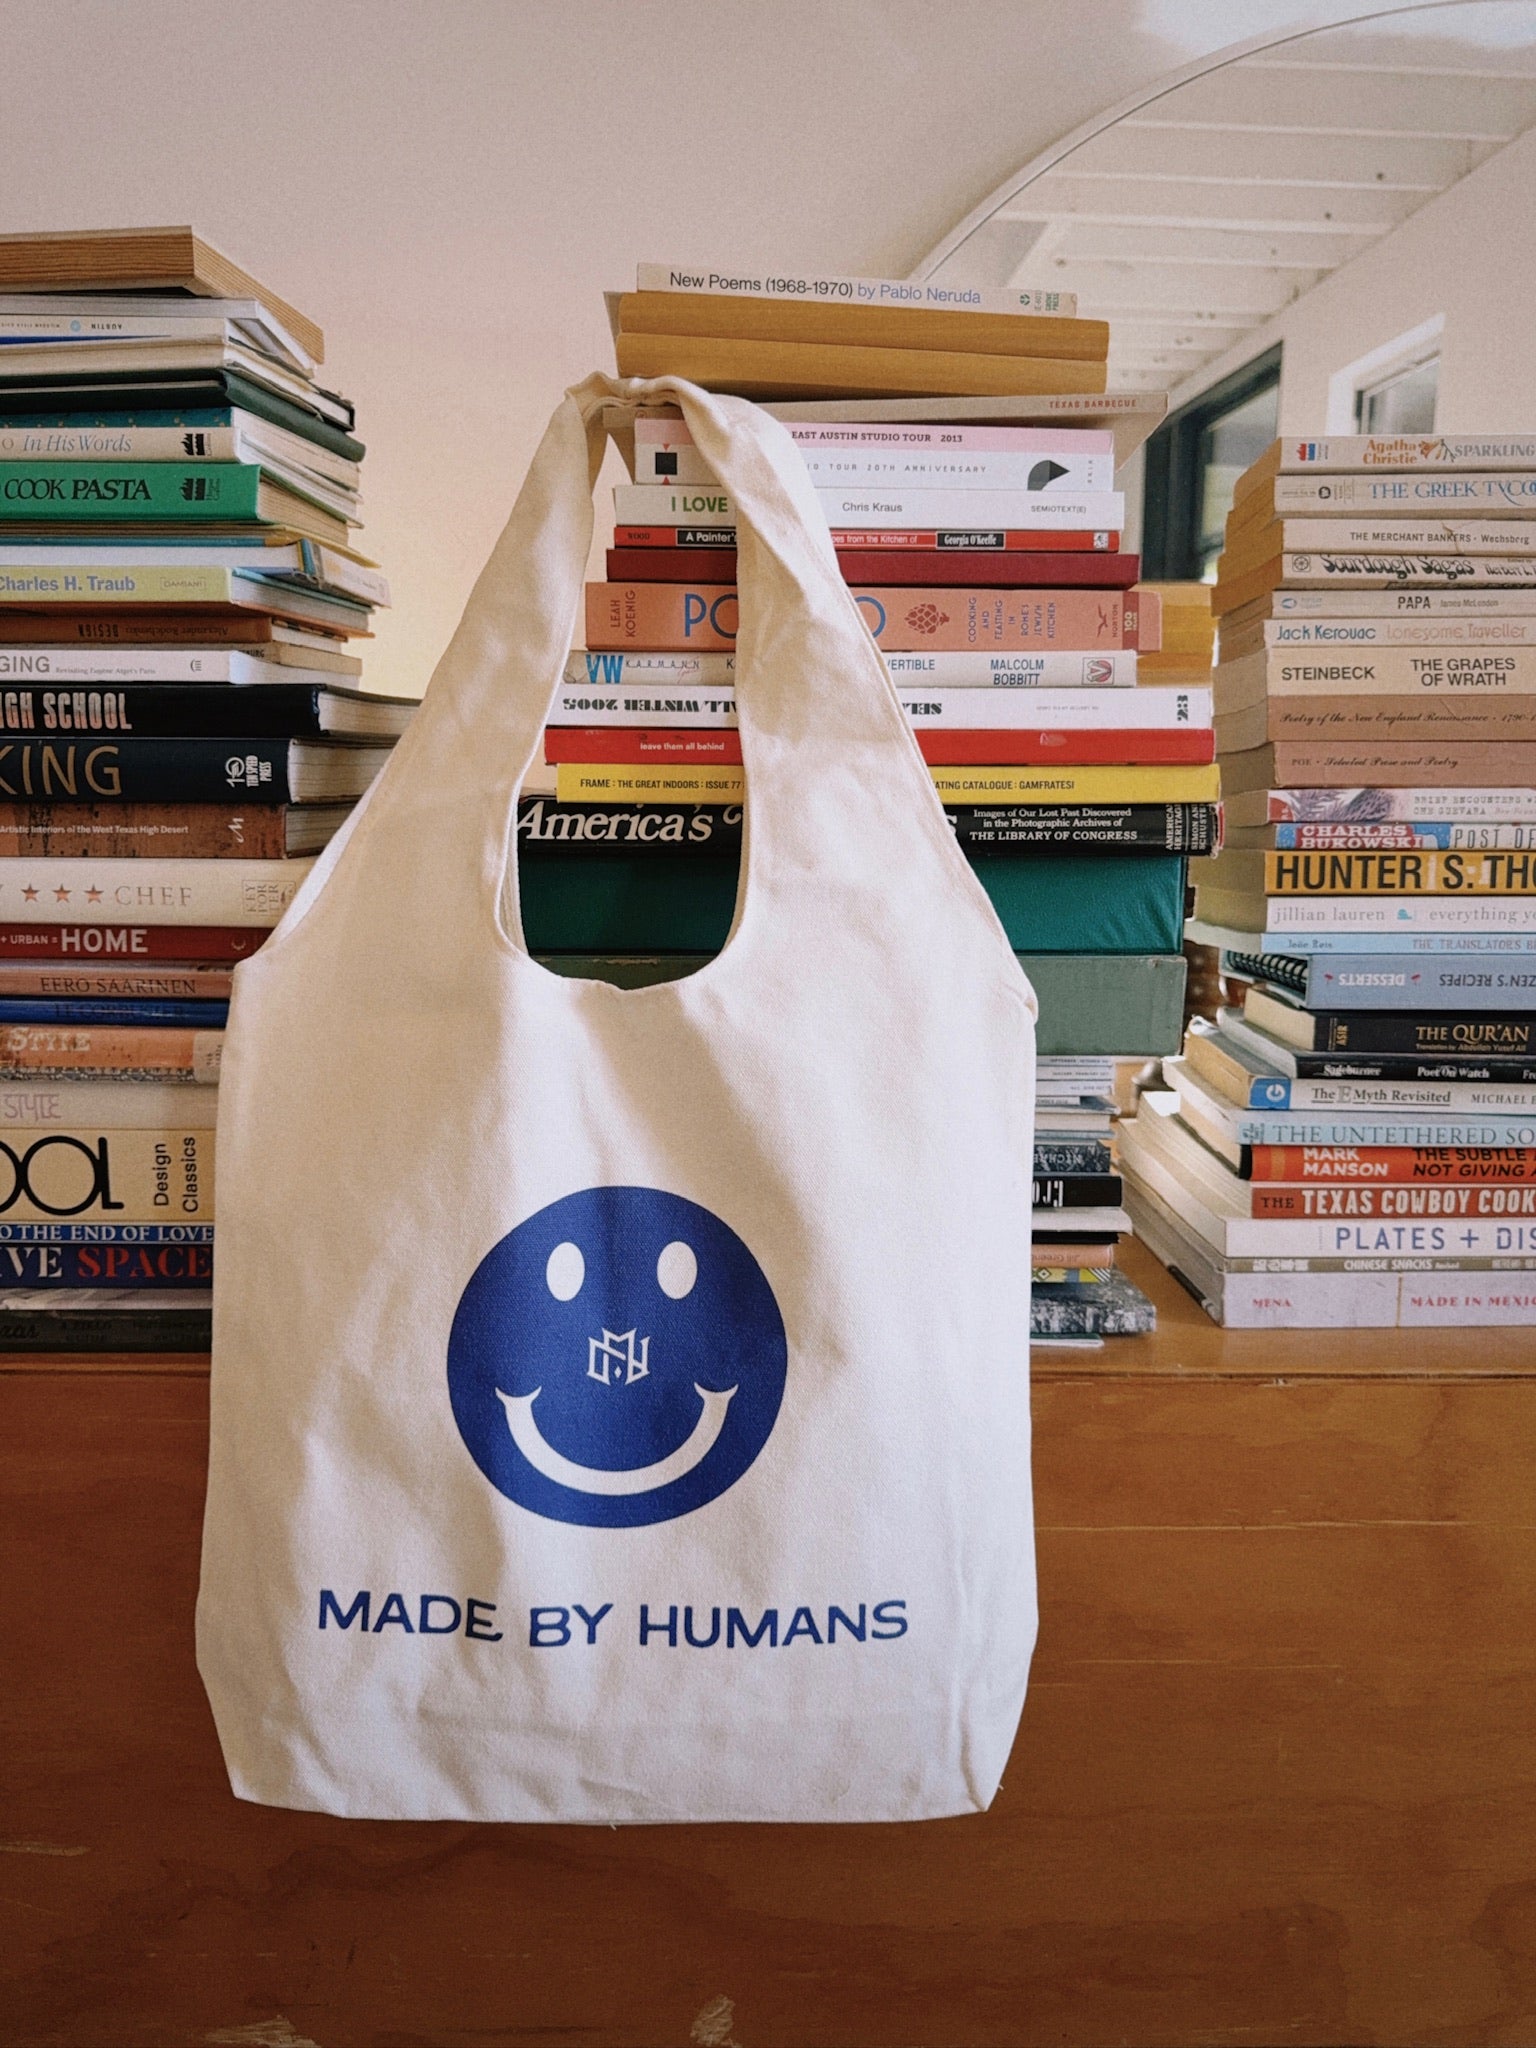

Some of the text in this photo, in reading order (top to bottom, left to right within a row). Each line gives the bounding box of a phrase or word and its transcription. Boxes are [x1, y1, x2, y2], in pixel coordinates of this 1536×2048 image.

[670, 272, 981, 305] New Poems (1968-1970) by Pablo Neruda
[91, 322, 122, 331] AUSTIN
[1050, 399, 1137, 409] TEXAS BARBECUE
[23, 434, 132, 452] In His Words
[791, 431, 963, 444] EAST AUSTIN STUDIO TOUR 2013
[1366, 439, 1418, 455] Agatha
[1454, 443, 1535, 458] SPARKLING
[1363, 452, 1418, 465] Christie
[904, 465, 987, 473] ANNIVERSARY
[5, 478, 153, 501] COOK PASTA
[1368, 480, 1478, 500] THE GREEK
[683, 496, 728, 512] LOVE
[842, 502, 903, 513] Chris Kraus
[1031, 505, 1087, 514] SEMIOTEXT(E)
[686, 532, 693, 542] A
[847, 534, 907, 544] from the Kitchen
[944, 534, 969, 547] Georgia
[1350, 532, 1471, 543] THE MERCHANT BANKERS
[1417, 554, 1475, 580] Sagas
[0, 576, 136, 592] Charles H. Traub
[1397, 596, 1431, 610] PAPA
[610, 600, 621, 628] LEAH
[625, 589, 637, 637] KOENIG
[968, 597, 977, 643] COOKING
[982, 610, 990, 629] AND
[994, 600, 1003, 640] FEASTING
[1048, 602, 1057, 639] KITCHEN
[79, 623, 119, 638] DESIGN
[1277, 624, 1528, 641] Jack Kerouac Lonesome Traveller
[586, 654, 624, 684] VW
[990, 659, 1045, 671] MALCOLM
[1281, 657, 1517, 681] STEINBECK THE GRAPES
[993, 673, 1041, 686] BOBBITT
[1421, 672, 1507, 687] OF WRATH
[43, 692, 133, 730] SCHOOL
[563, 698, 619, 711] 2005
[1330, 712, 1347, 723] the
[1375, 712, 1421, 727] England
[640, 742, 724, 751] leave them all behind
[1424, 755, 1459, 769] Poetry
[580, 778, 741, 790] FRAME THE GREAT INDOORS ISSUE 77
[962, 780, 1075, 790] CATALOGUE GAMFRATESI
[973, 808, 1132, 819] Images of Our Lost Past Discovered
[517, 801, 713, 842] America's
[983, 818, 1123, 830] in the Photographic Archives of
[0, 825, 189, 836] Artistic the West Texas High Desert
[970, 830, 1138, 841] THE LIBRARY OF CONGRESS
[1301, 824, 1408, 838] CHARLES
[1300, 837, 1424, 849] BUKOWSKI
[1453, 828, 1501, 849] POST
[1275, 854, 1475, 890] HUNTER S.
[114, 885, 194, 907] CHEF
[1273, 906, 1518, 925] jillian lauren everything
[10, 928, 149, 953] URBAN HOME
[1412, 939, 1434, 950] THE
[40, 977, 197, 995] EERO SAARINEN
[1338, 973, 1493, 988] DESSERTS RECIPES
[1416, 1023, 1530, 1044] THE QUR'AN
[1458, 1066, 1491, 1079] Watch
[1312, 1087, 1527, 1105] The Myth Revisited MICHAEL
[1273, 1125, 1322, 1143] THE
[1331, 1126, 1497, 1144] UNTETHERED
[1303, 1147, 1361, 1162] MARK
[1413, 1148, 1527, 1162] THE SUBTLE
[153, 1142, 172, 1206] Design
[181, 1136, 200, 1213] Classics
[1303, 1162, 1389, 1177] MANSON
[1411, 1163, 1525, 1177] NOT GIVING
[1261, 1189, 1472, 1215] THE TEXAS COWBOY
[16, 1226, 214, 1242] THE END OF LOVE
[1335, 1226, 1446, 1251] PLATES
[77, 1246, 212, 1278] SPACE
[1343, 1258, 1434, 1272] CHINESE SNACKS
[1252, 1296, 1483, 1309] MENA MADE IN
[318, 1589, 909, 1649] MADE BY HUMANS
